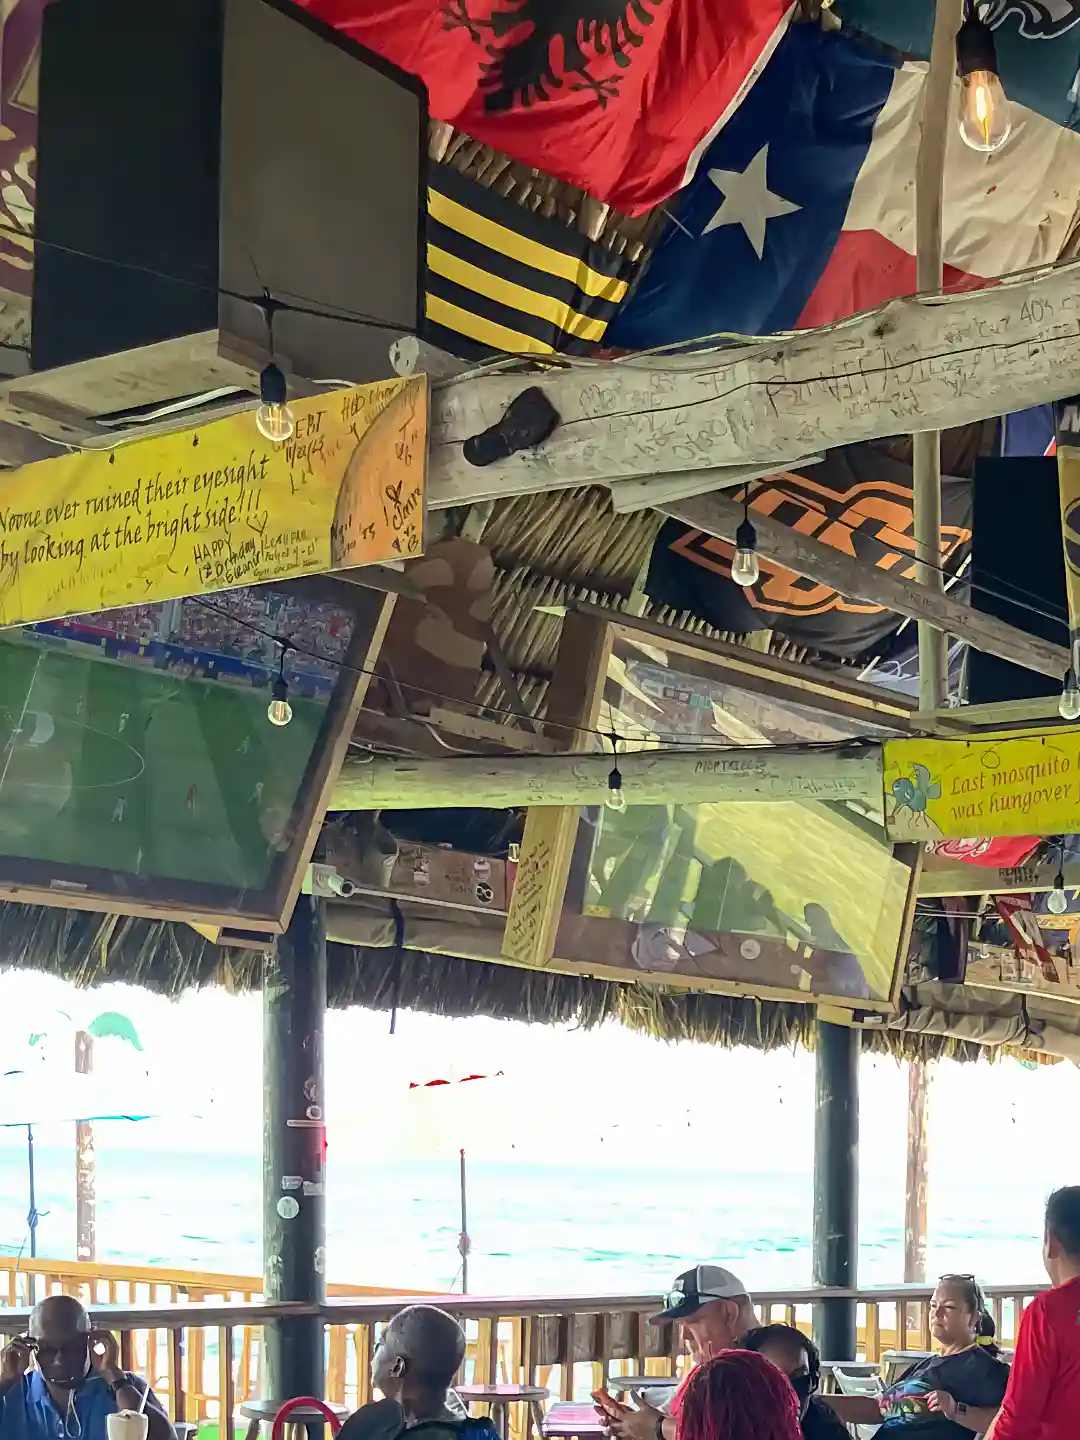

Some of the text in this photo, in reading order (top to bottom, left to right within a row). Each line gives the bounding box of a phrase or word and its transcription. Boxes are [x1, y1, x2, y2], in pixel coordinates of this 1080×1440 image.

[46, 503, 80, 525] ever
[86, 479, 141, 516] ruined
[145, 468, 189, 504] their
[193, 450, 269, 509] eyesight
[0, 540, 20, 583] by
[23, 532, 85, 573] looking
[90, 527, 110, 552] at
[115, 515, 142, 545] the
[146, 503, 201, 574] bright
[194, 531, 231, 564] HAPPY
[950, 770, 987, 796] Last
[991, 757, 1071, 786] mosquito
[951, 797, 984, 822] was
[989, 781, 1072, 814] hungover
